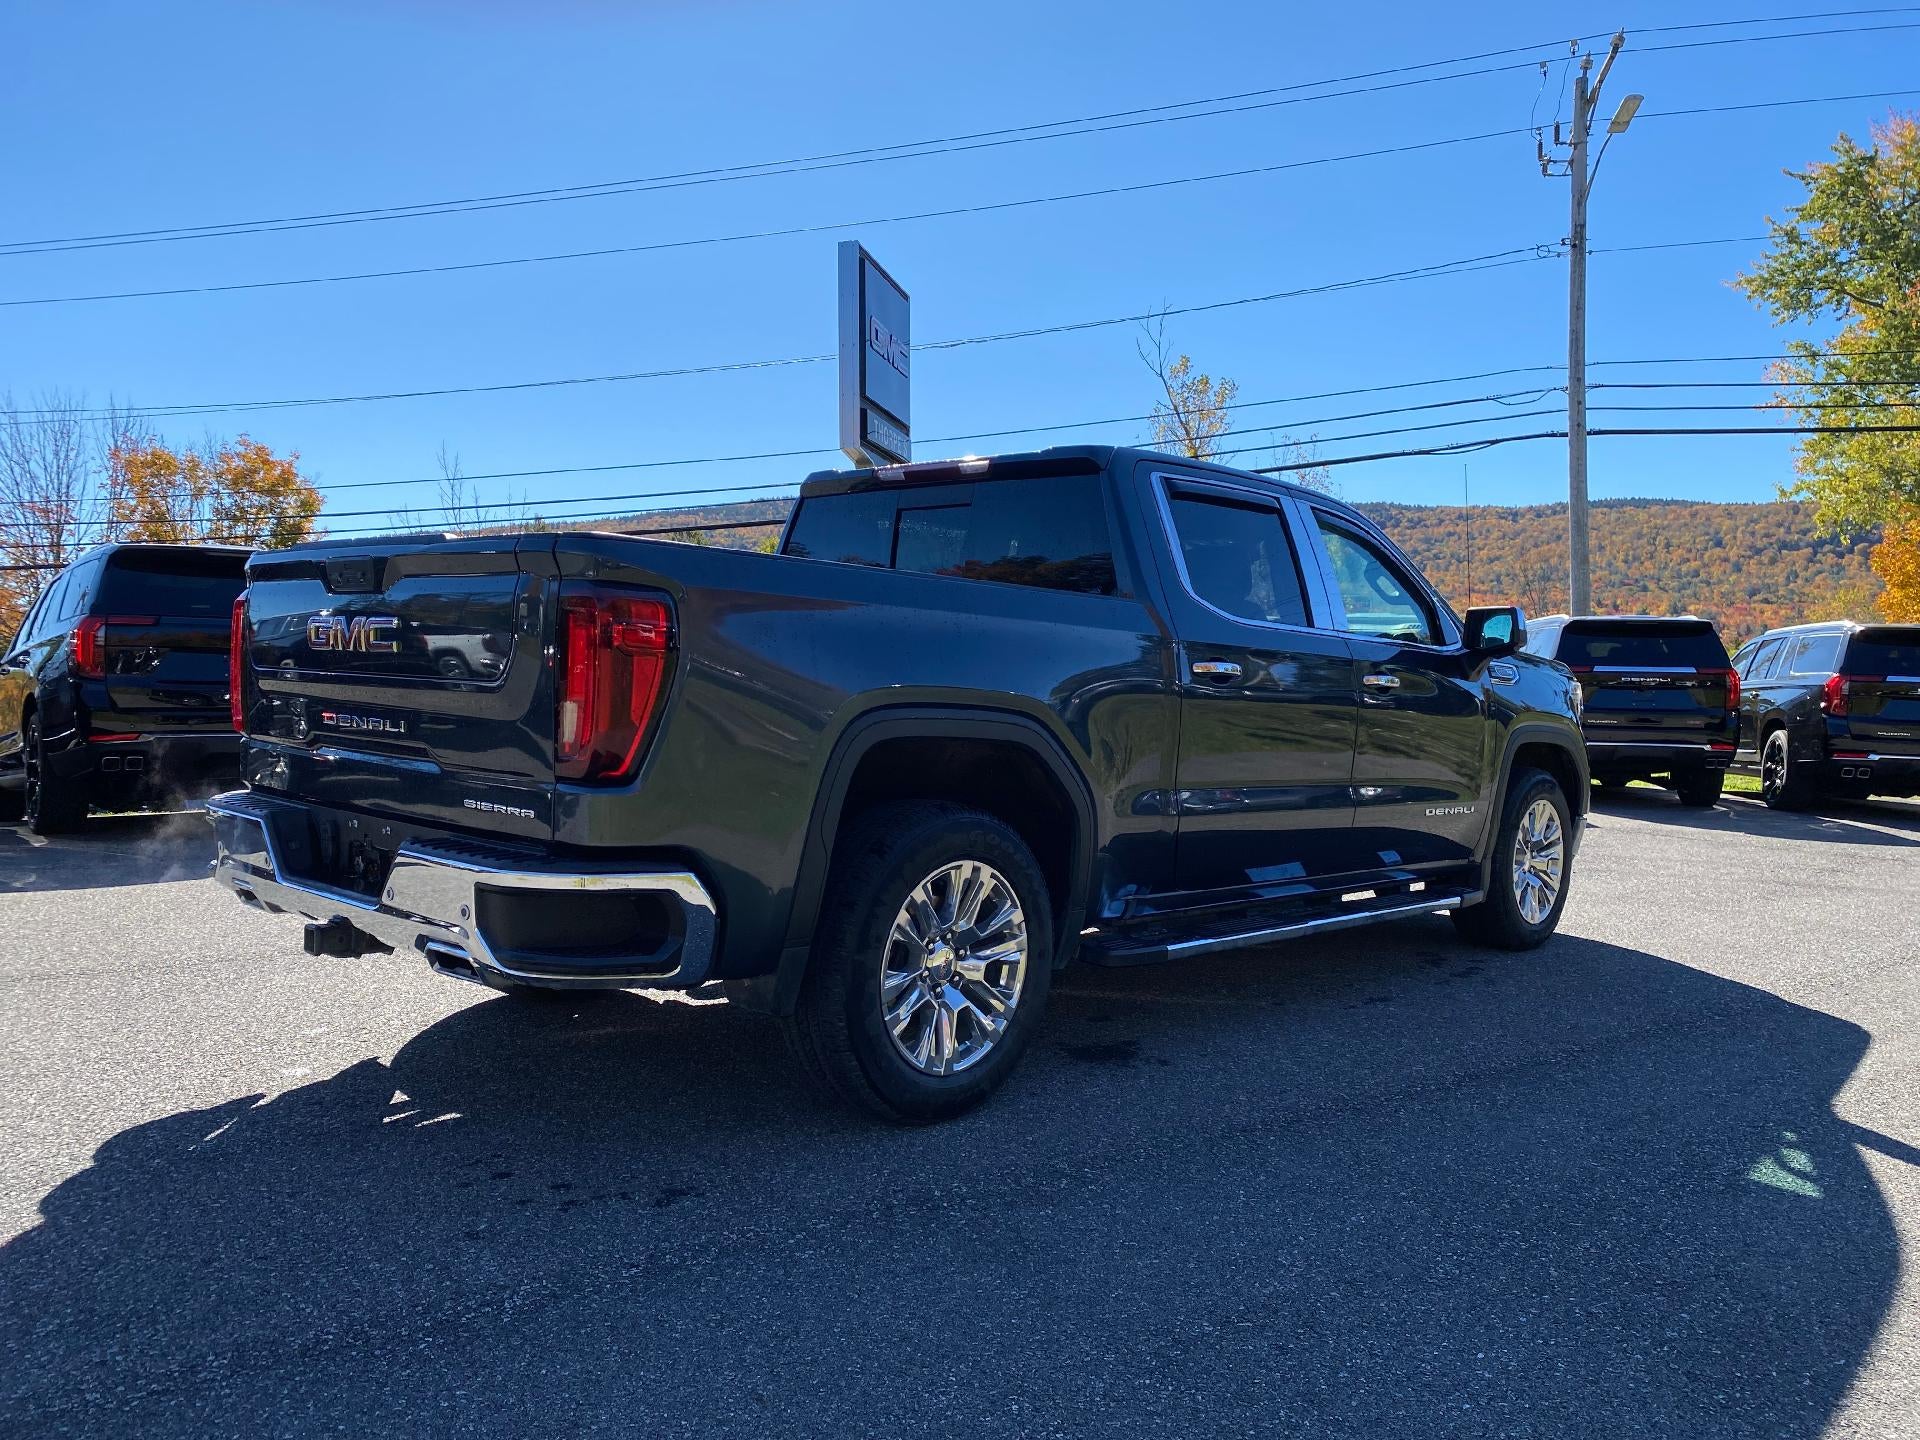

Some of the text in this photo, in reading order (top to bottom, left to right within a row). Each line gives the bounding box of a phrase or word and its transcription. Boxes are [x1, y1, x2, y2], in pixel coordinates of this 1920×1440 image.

[869, 315, 908, 378] GMC
[307, 616, 401, 652] GMC
[321, 712, 405, 732] DENALI
[463, 799, 535, 819] SIERRA
[1425, 805, 1475, 817] DENALI
